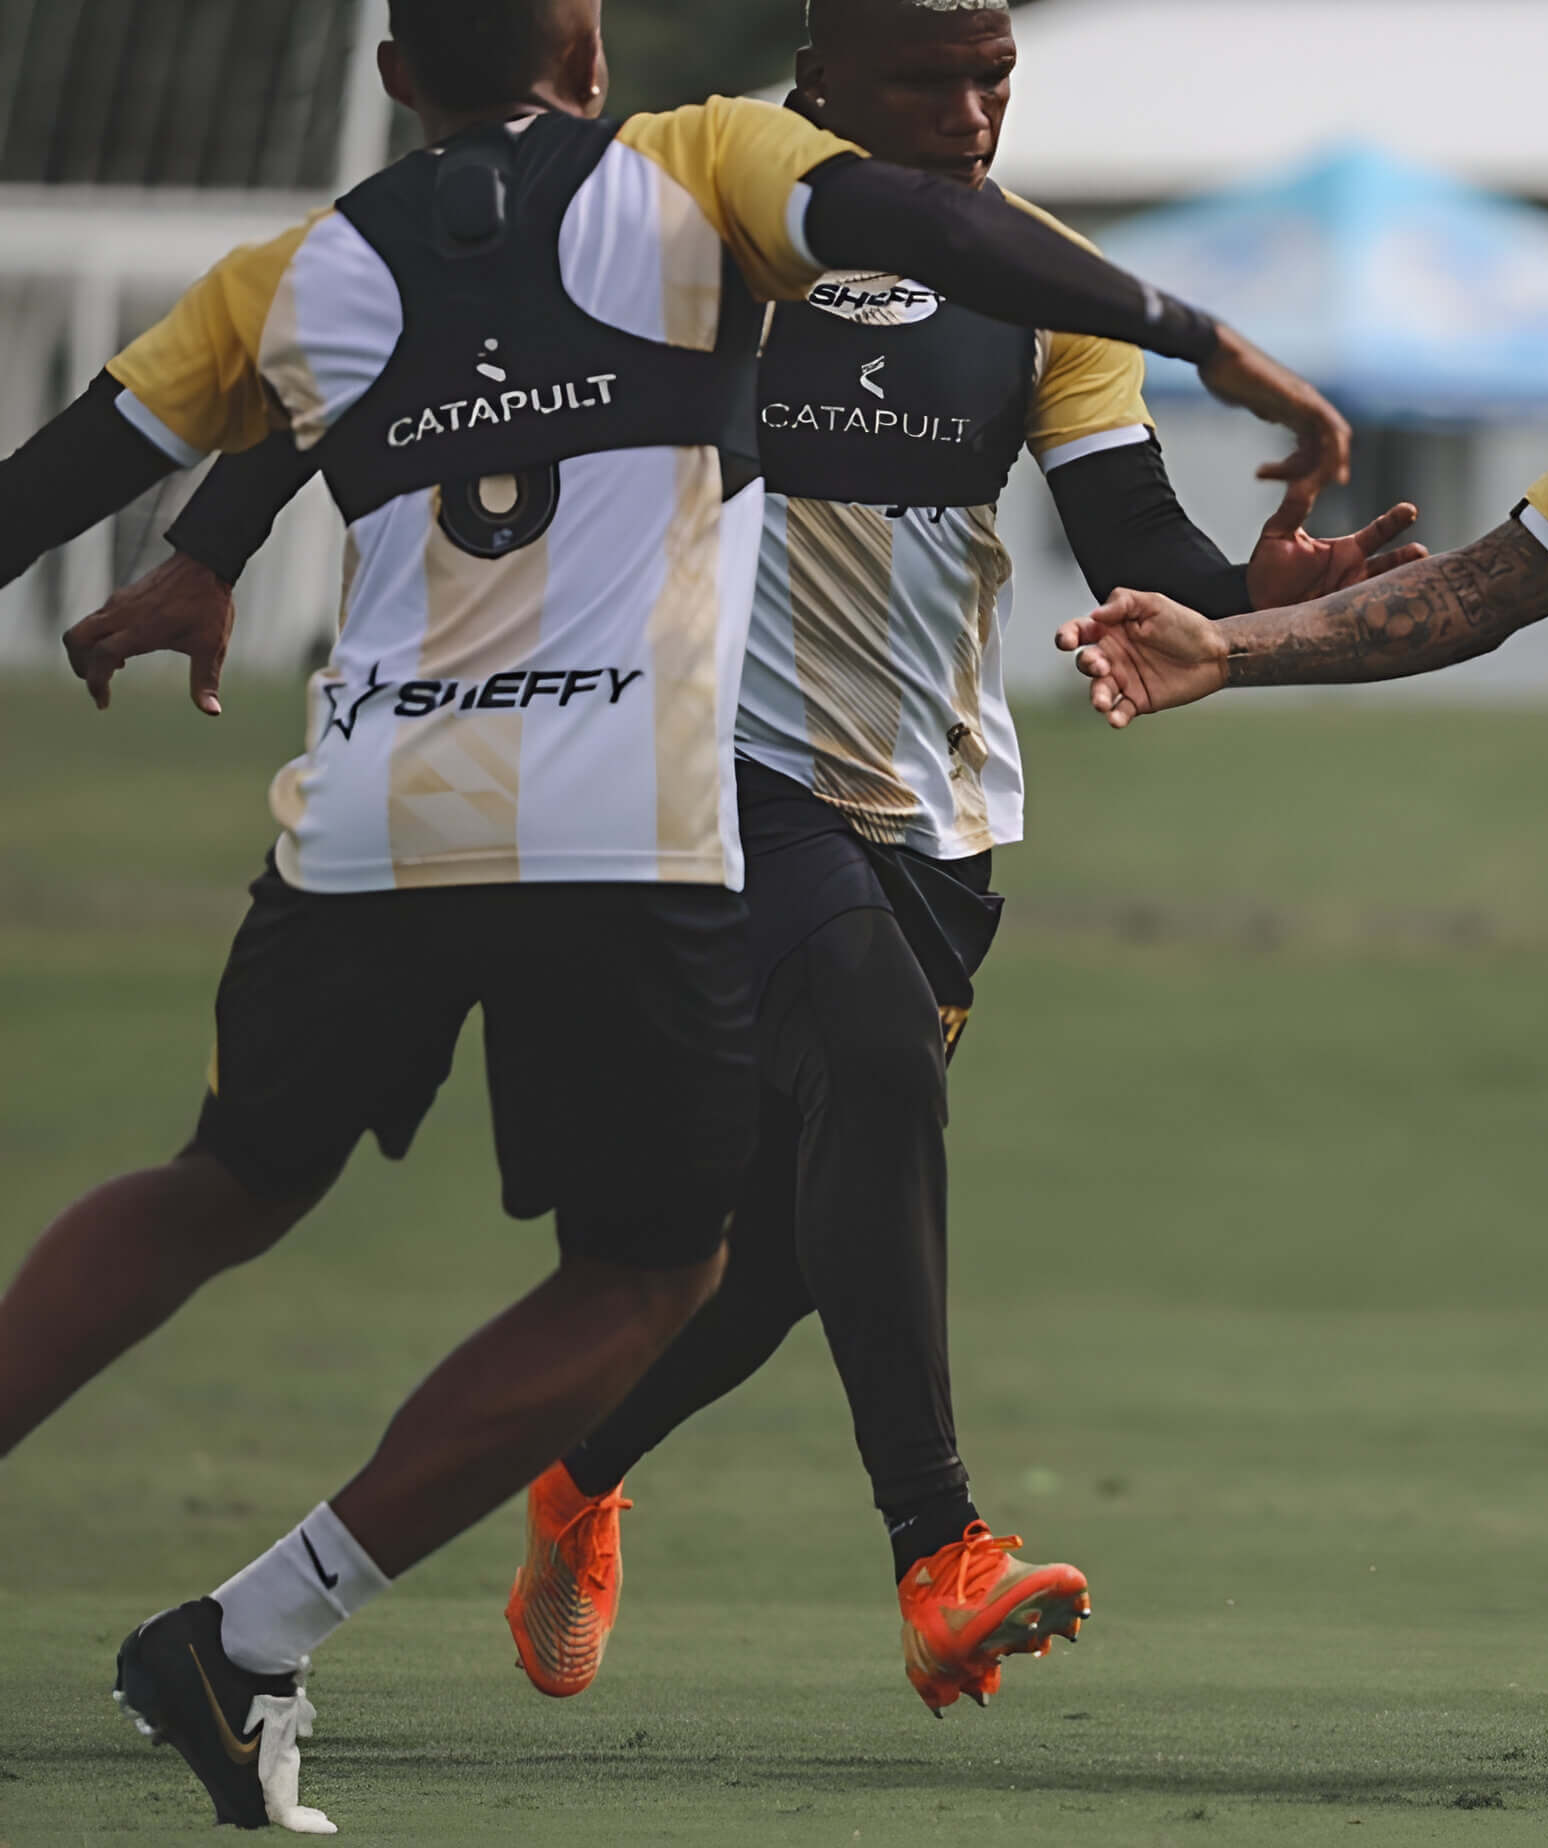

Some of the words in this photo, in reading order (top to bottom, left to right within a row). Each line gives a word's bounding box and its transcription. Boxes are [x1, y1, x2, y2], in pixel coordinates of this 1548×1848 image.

[808, 283, 942, 309] SHEFF
[387, 374, 617, 447] CATAPULT
[761, 403, 971, 443] CATAPULT
